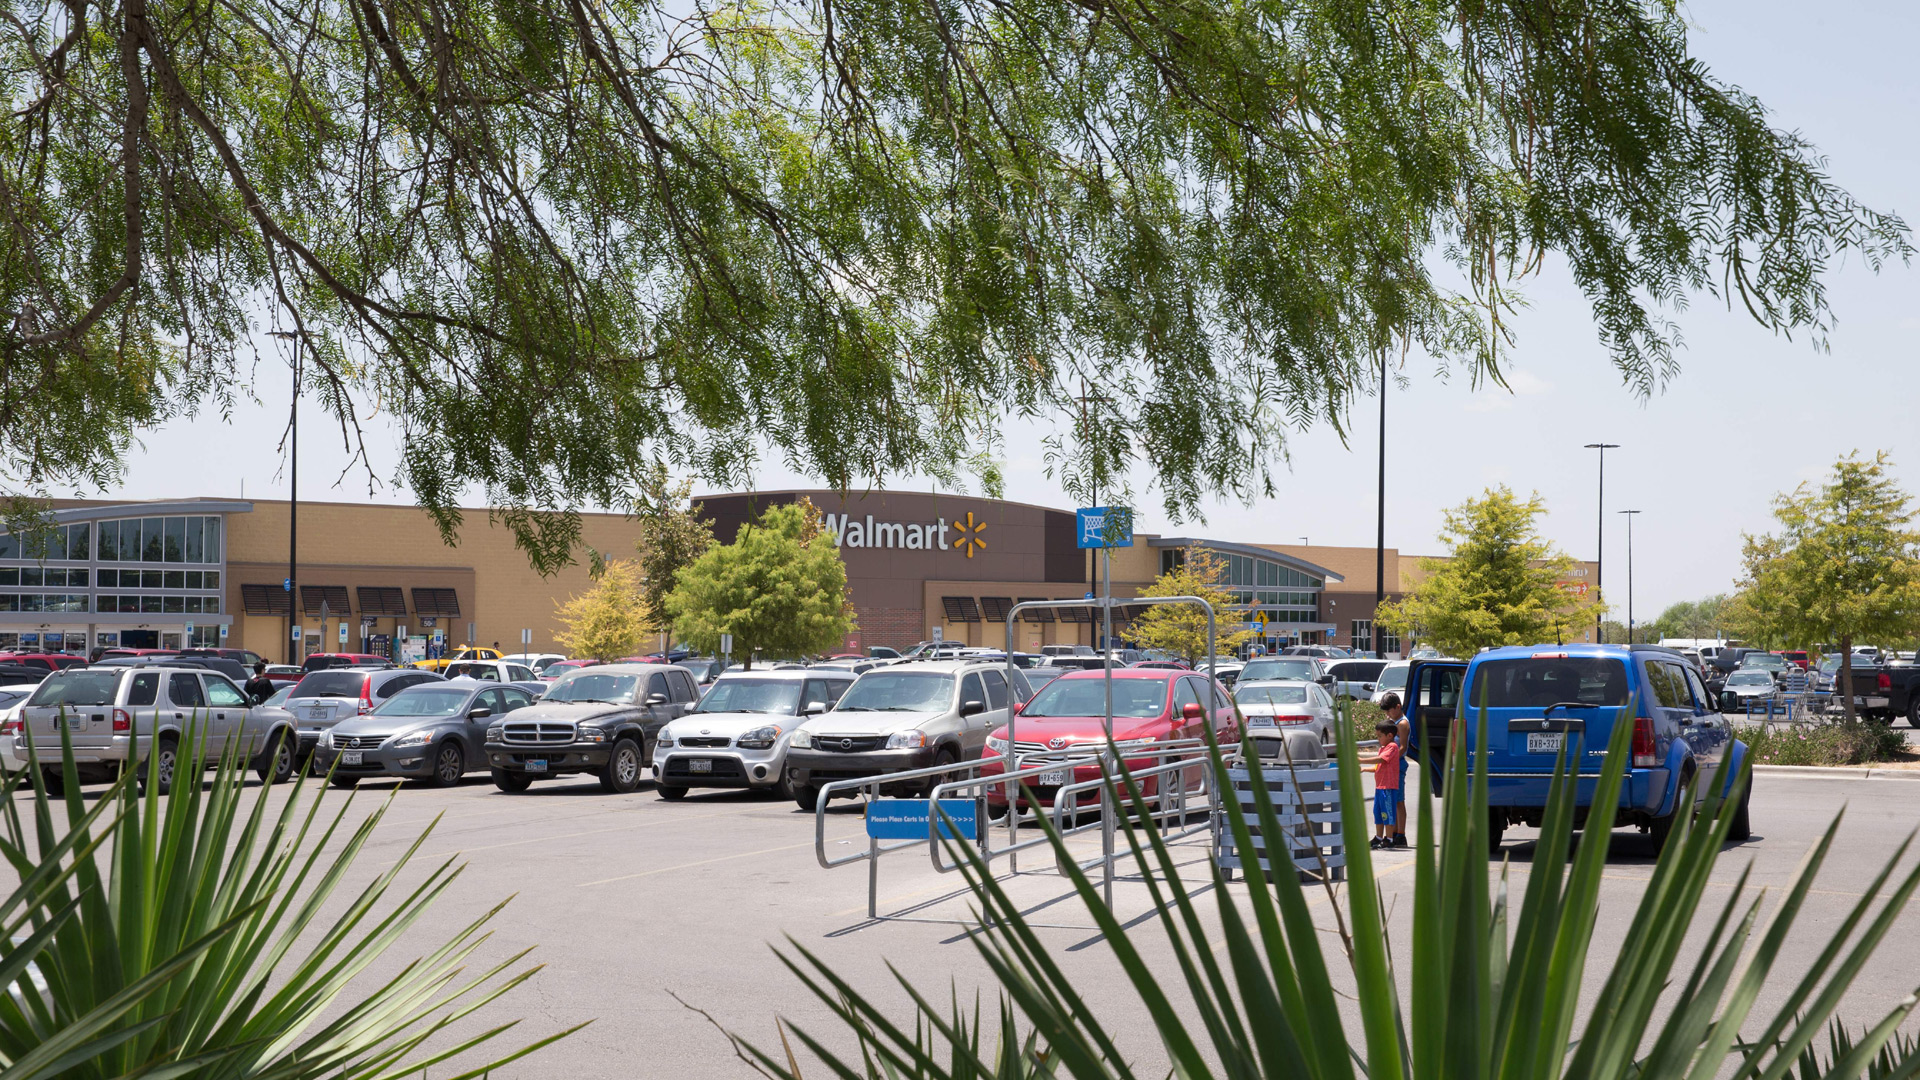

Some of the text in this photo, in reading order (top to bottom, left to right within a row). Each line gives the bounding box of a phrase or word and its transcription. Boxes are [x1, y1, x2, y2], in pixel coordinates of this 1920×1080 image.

[819, 513, 949, 550] Walmart
[871, 815, 887, 823] Please
[889, 815, 903, 823] Place
[904, 815, 917, 823] Carts
